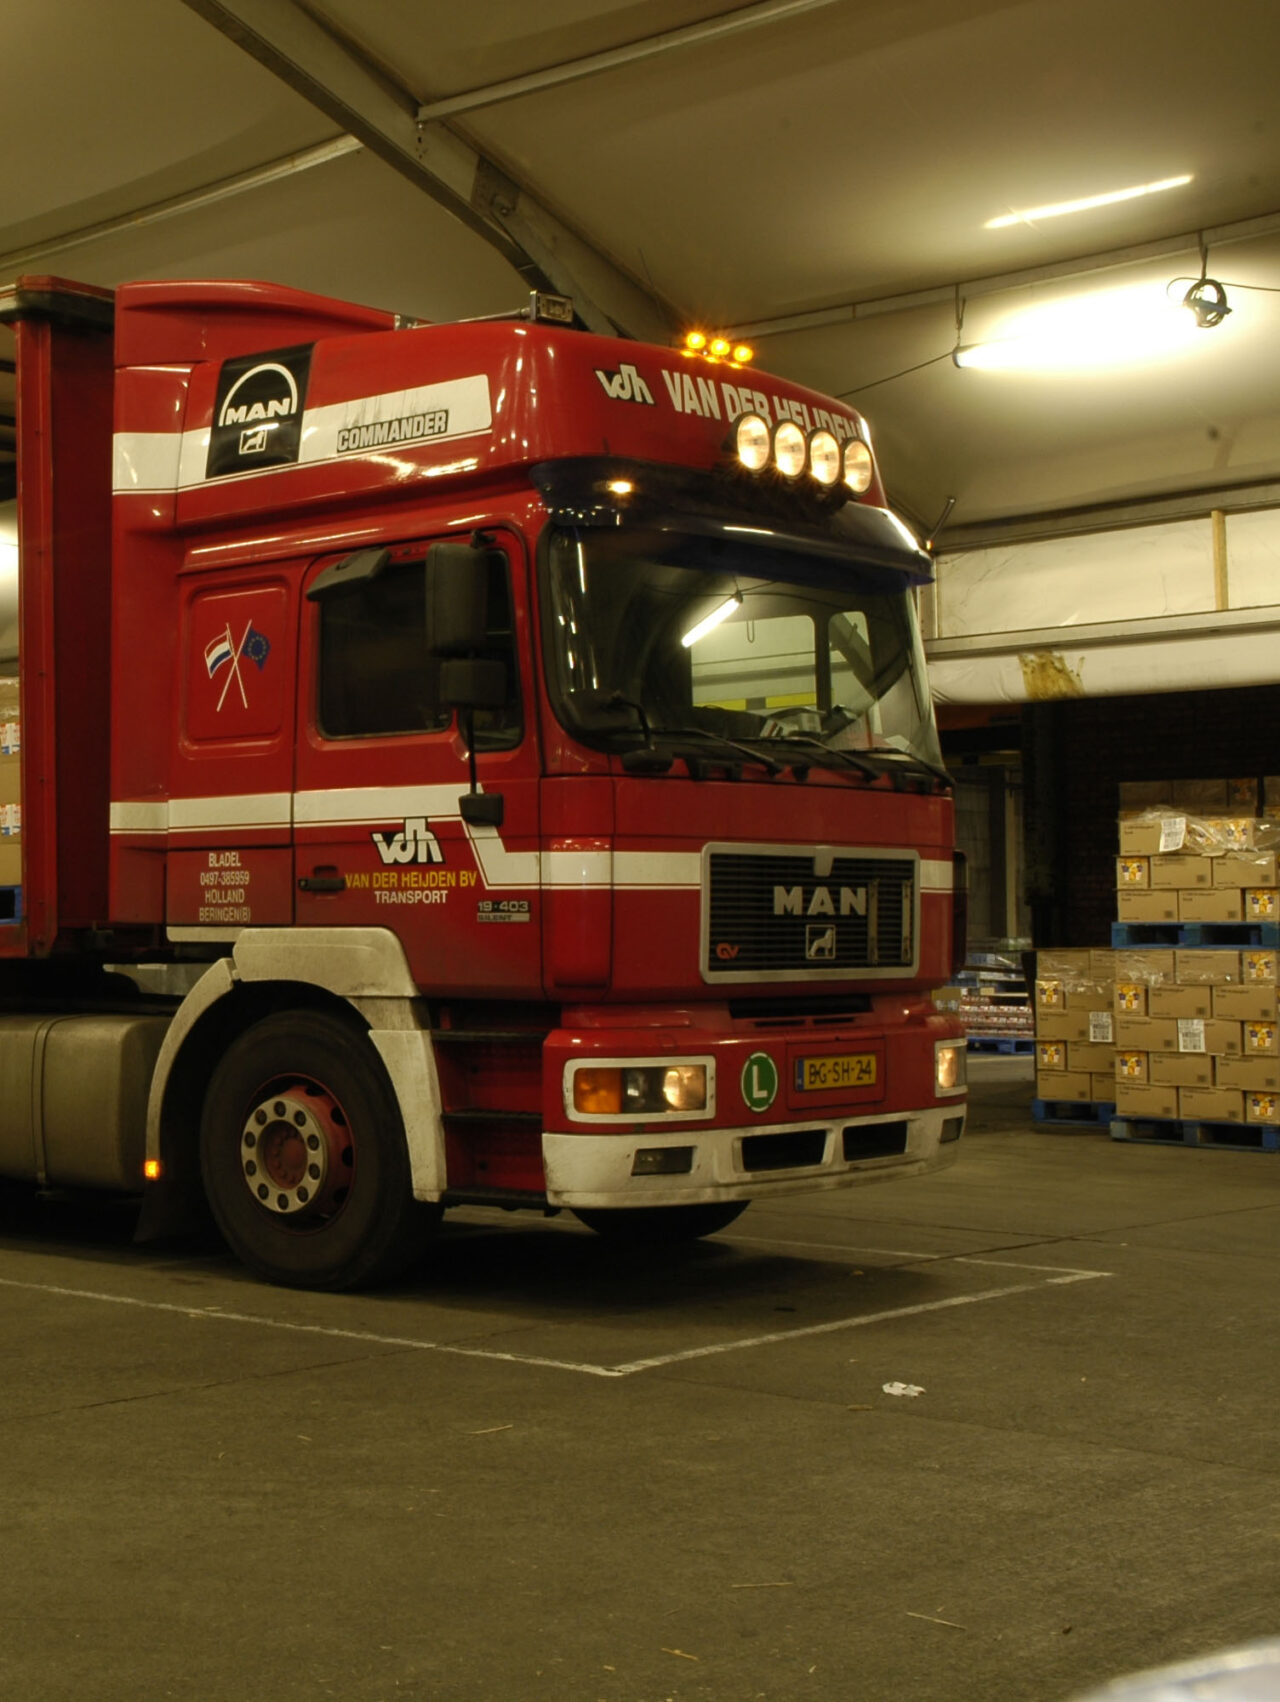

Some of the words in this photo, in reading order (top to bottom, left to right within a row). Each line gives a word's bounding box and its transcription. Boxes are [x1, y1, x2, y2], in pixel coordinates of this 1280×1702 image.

[225, 397, 291, 426] MAN
[661, 369, 721, 420] VAN
[721, 382, 772, 429] DER
[336, 410, 448, 453] COMMANDER
[208, 851, 241, 867] BLADEL
[345, 873, 369, 888] VAN
[372, 872, 398, 888] DER
[401, 871, 456, 888] HEIJDEN
[459, 871, 477, 887] BV
[205, 889, 245, 904] HOLLAND
[374, 890, 448, 904] TRANSPORT
[773, 885, 867, 916] MAN
[752, 1064, 768, 1099] L
[809, 1059, 872, 1085] BG-SH-24
